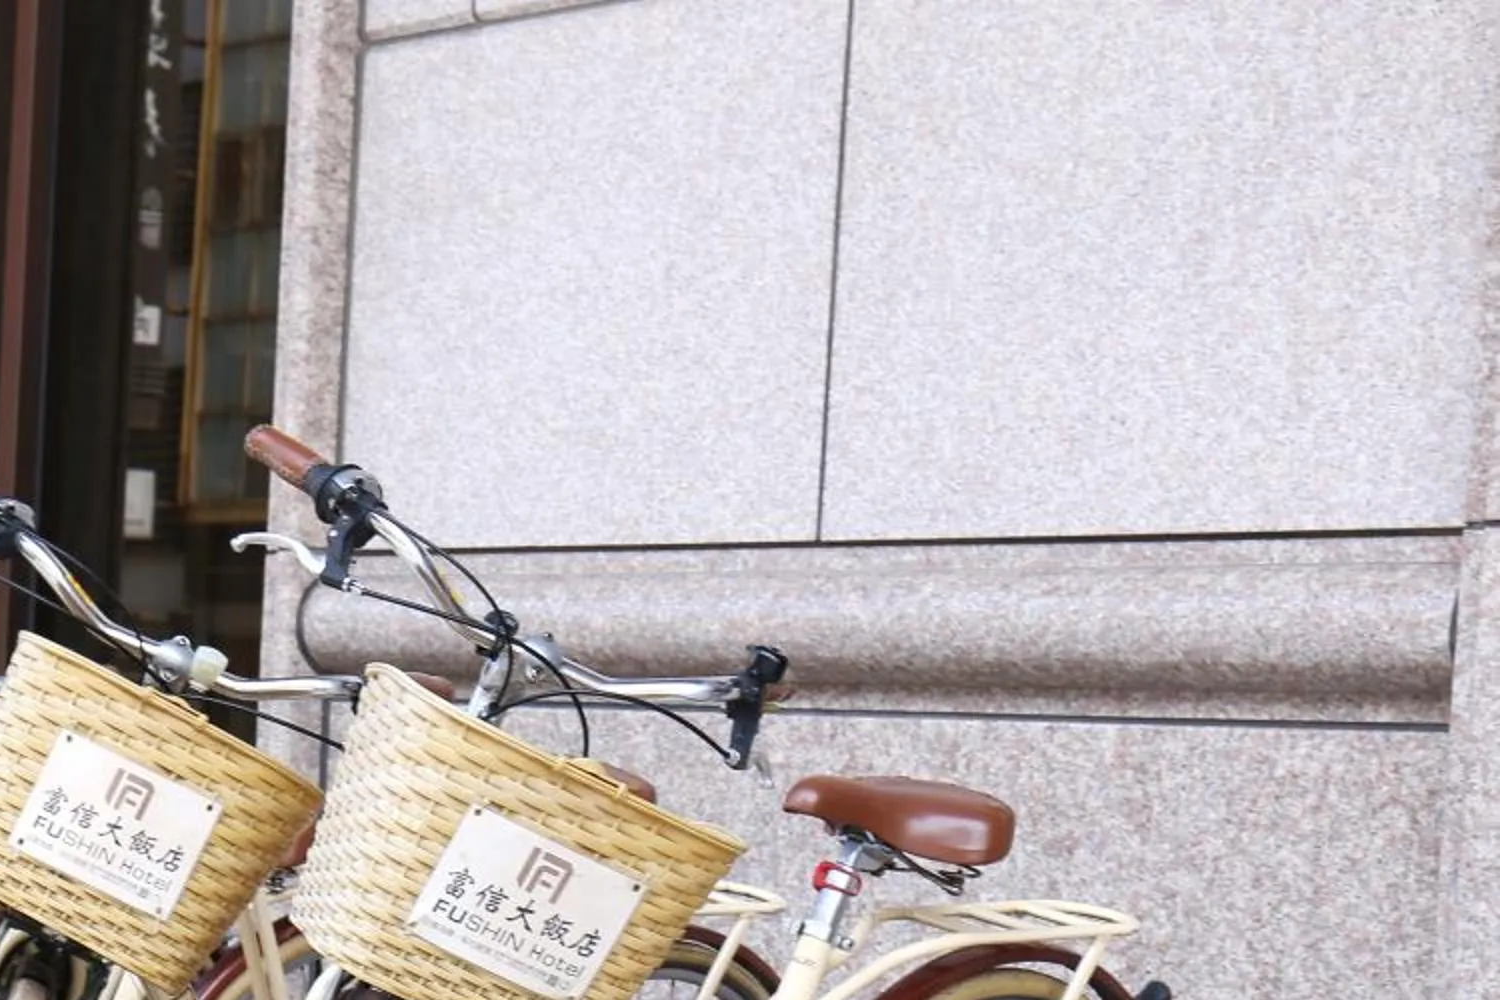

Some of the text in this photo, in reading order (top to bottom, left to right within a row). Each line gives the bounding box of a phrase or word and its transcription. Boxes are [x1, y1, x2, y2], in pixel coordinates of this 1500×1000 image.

[33, 815, 115, 865] FUSHIN
[119, 857, 174, 893] Hotel
[43, 786, 185, 873] 富信大飯店
[432, 898, 525, 953] FUSHIN
[531, 945, 587, 978] Hotel
[443, 868, 601, 958] 富信大飯店
